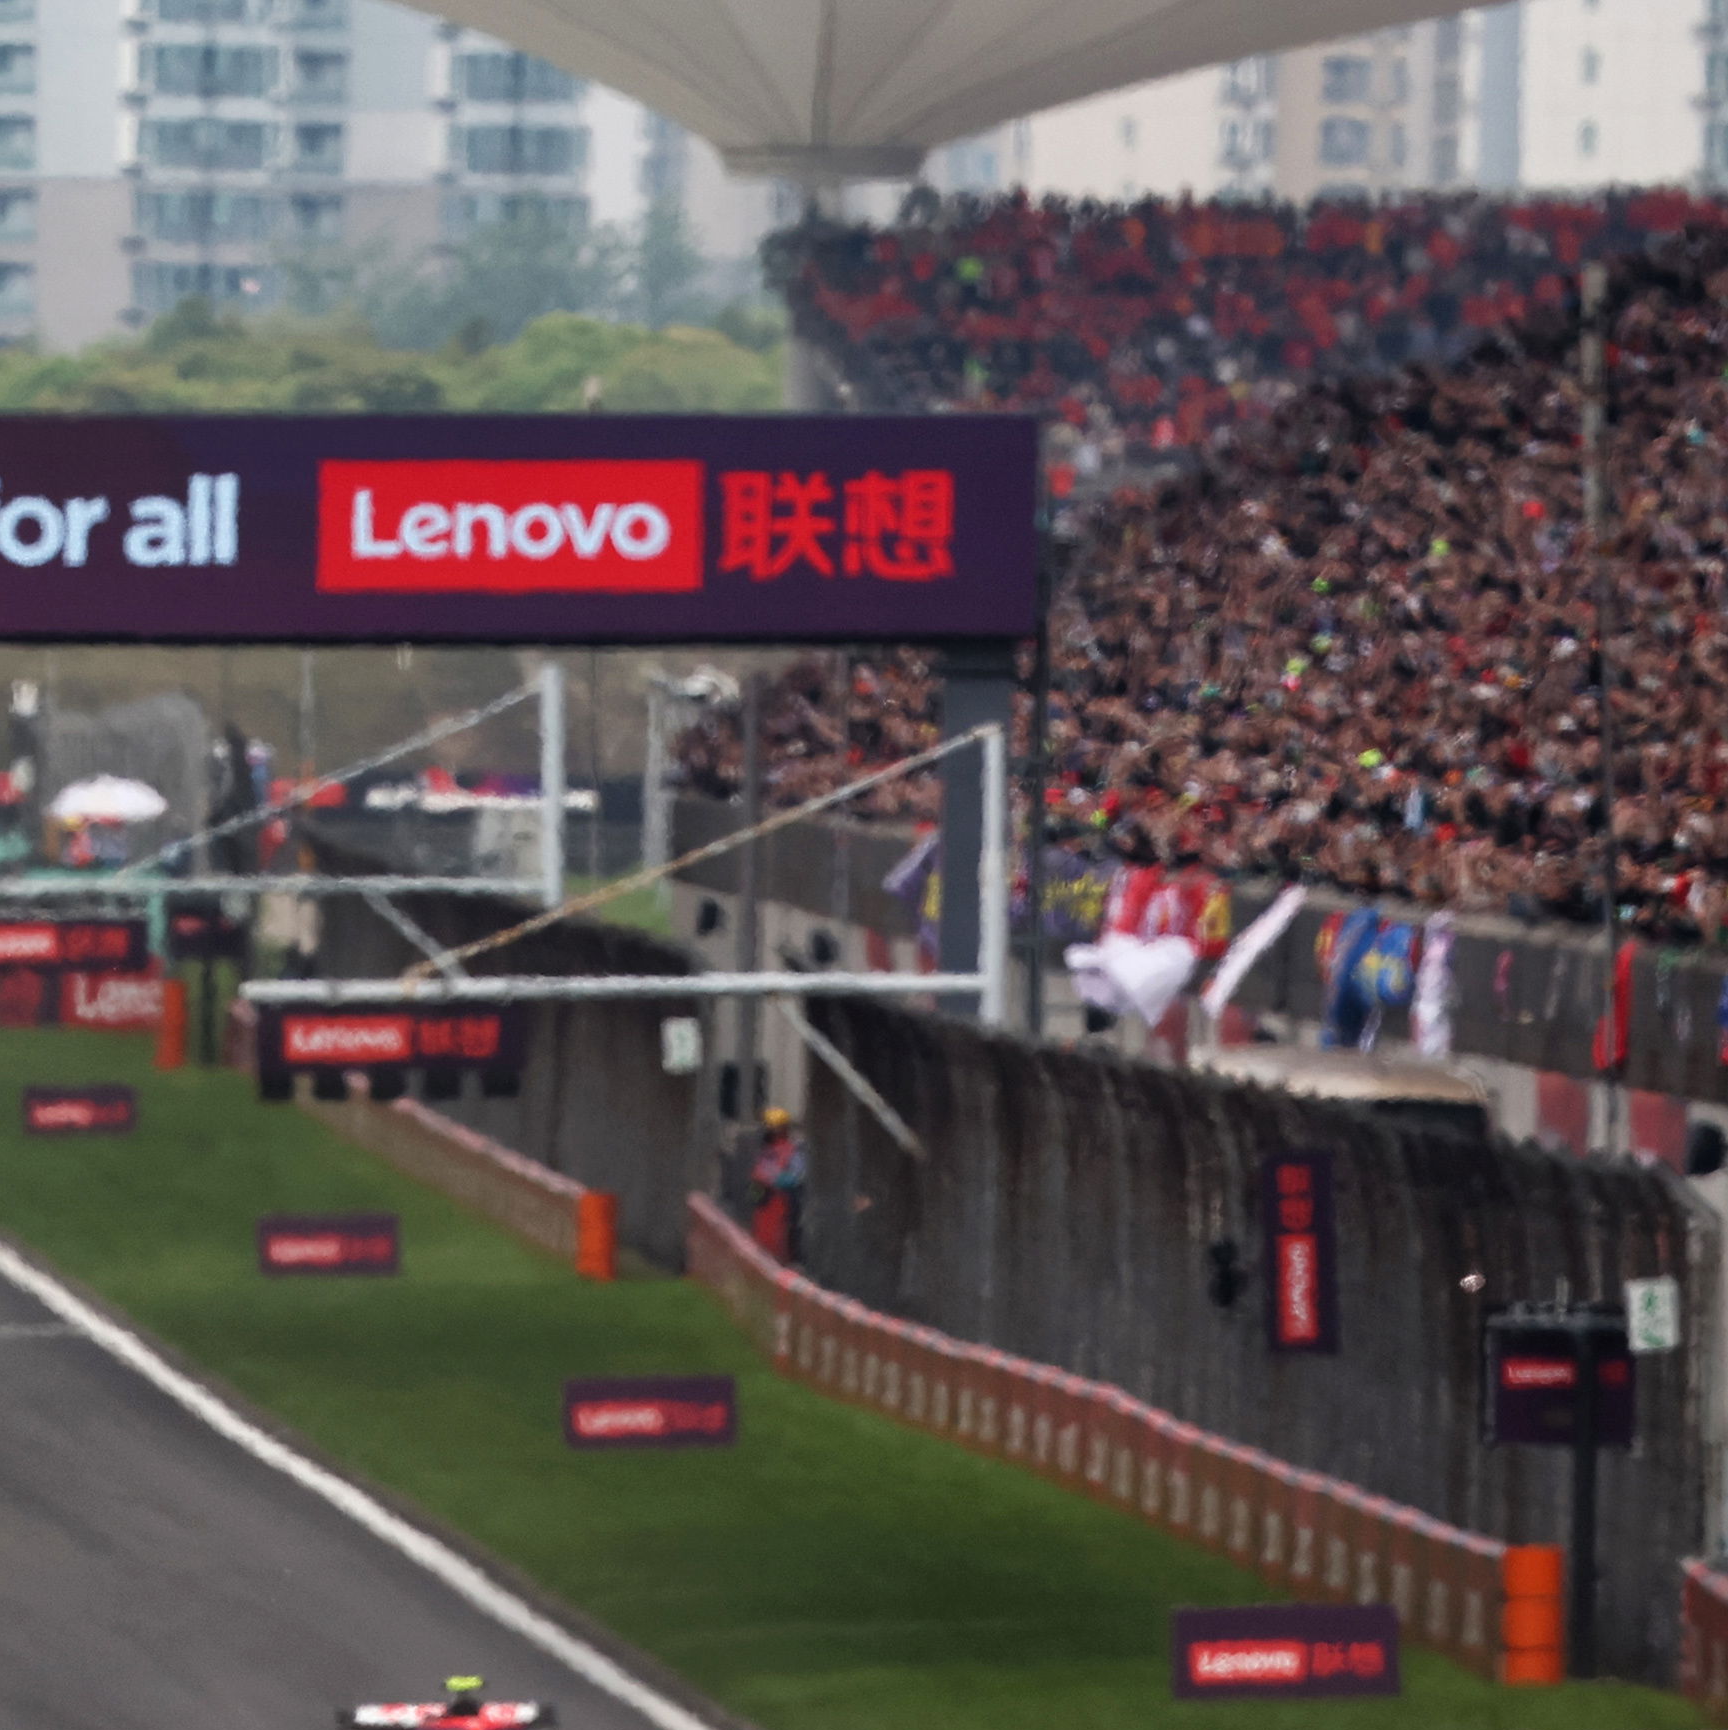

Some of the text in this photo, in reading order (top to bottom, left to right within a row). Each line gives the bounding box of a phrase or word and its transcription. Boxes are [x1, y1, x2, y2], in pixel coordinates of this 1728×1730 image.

[122, 472, 241, 567] all
[349, 468, 956, 582] Lenovo 联想
